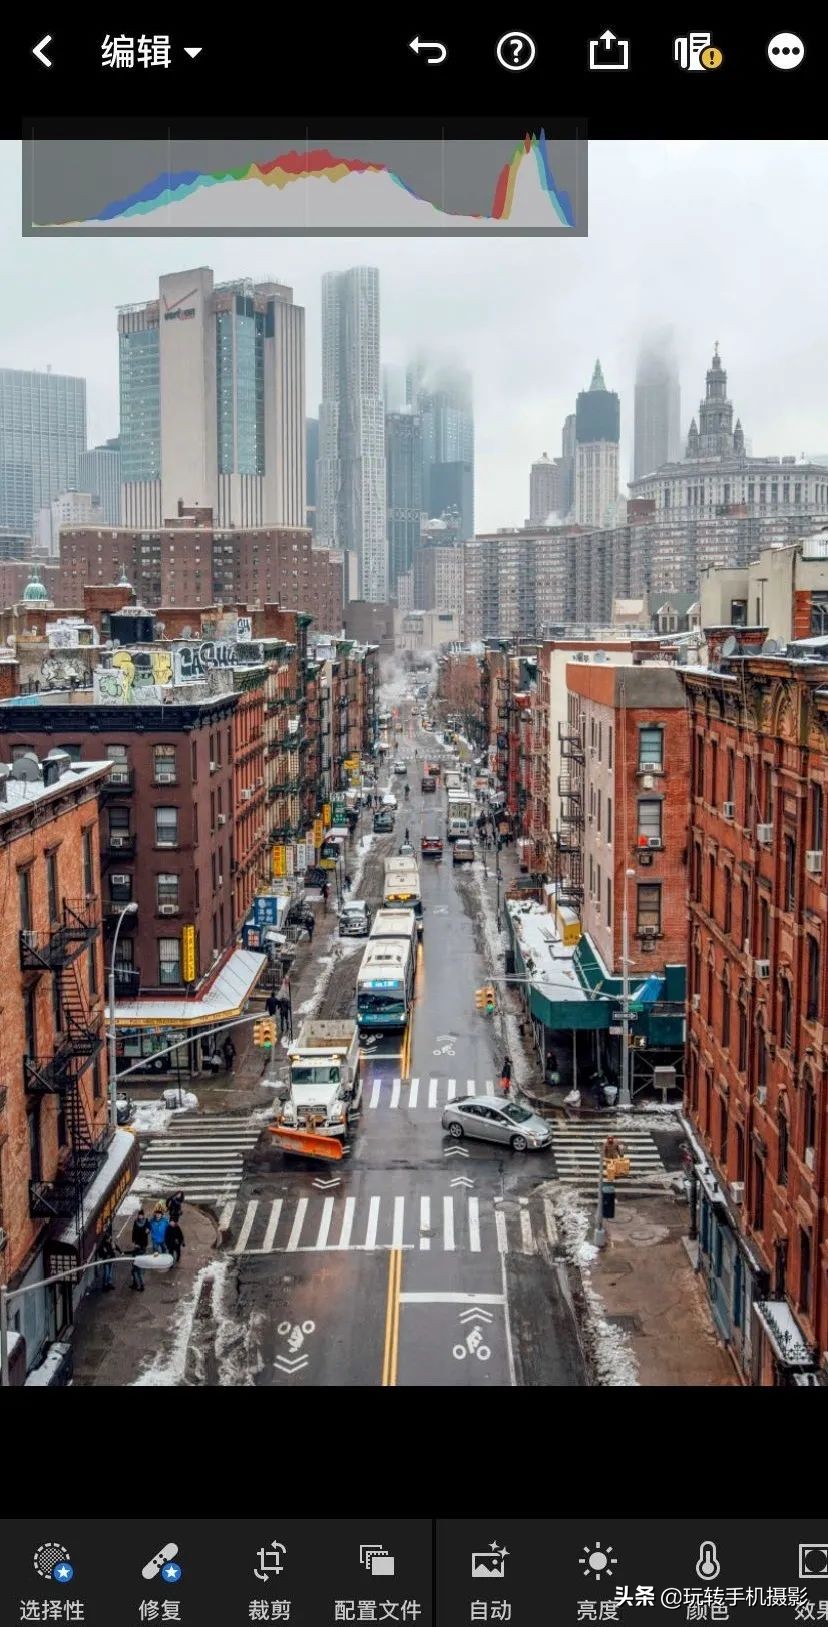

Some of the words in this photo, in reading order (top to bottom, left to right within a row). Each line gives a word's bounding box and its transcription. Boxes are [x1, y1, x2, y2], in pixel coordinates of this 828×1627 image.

[101, 34, 171, 68] 编辑
[20, 1600, 84, 1620] 选择性
[139, 1600, 181, 1620] 修复
[249, 1600, 291, 1620] 裁剪
[335, 1600, 421, 1621] 配置文件
[471, 1600, 511, 1620] 自动
[576, 1600, 620, 1621] 亮度
[686, 1600, 730, 1621] 颜色
